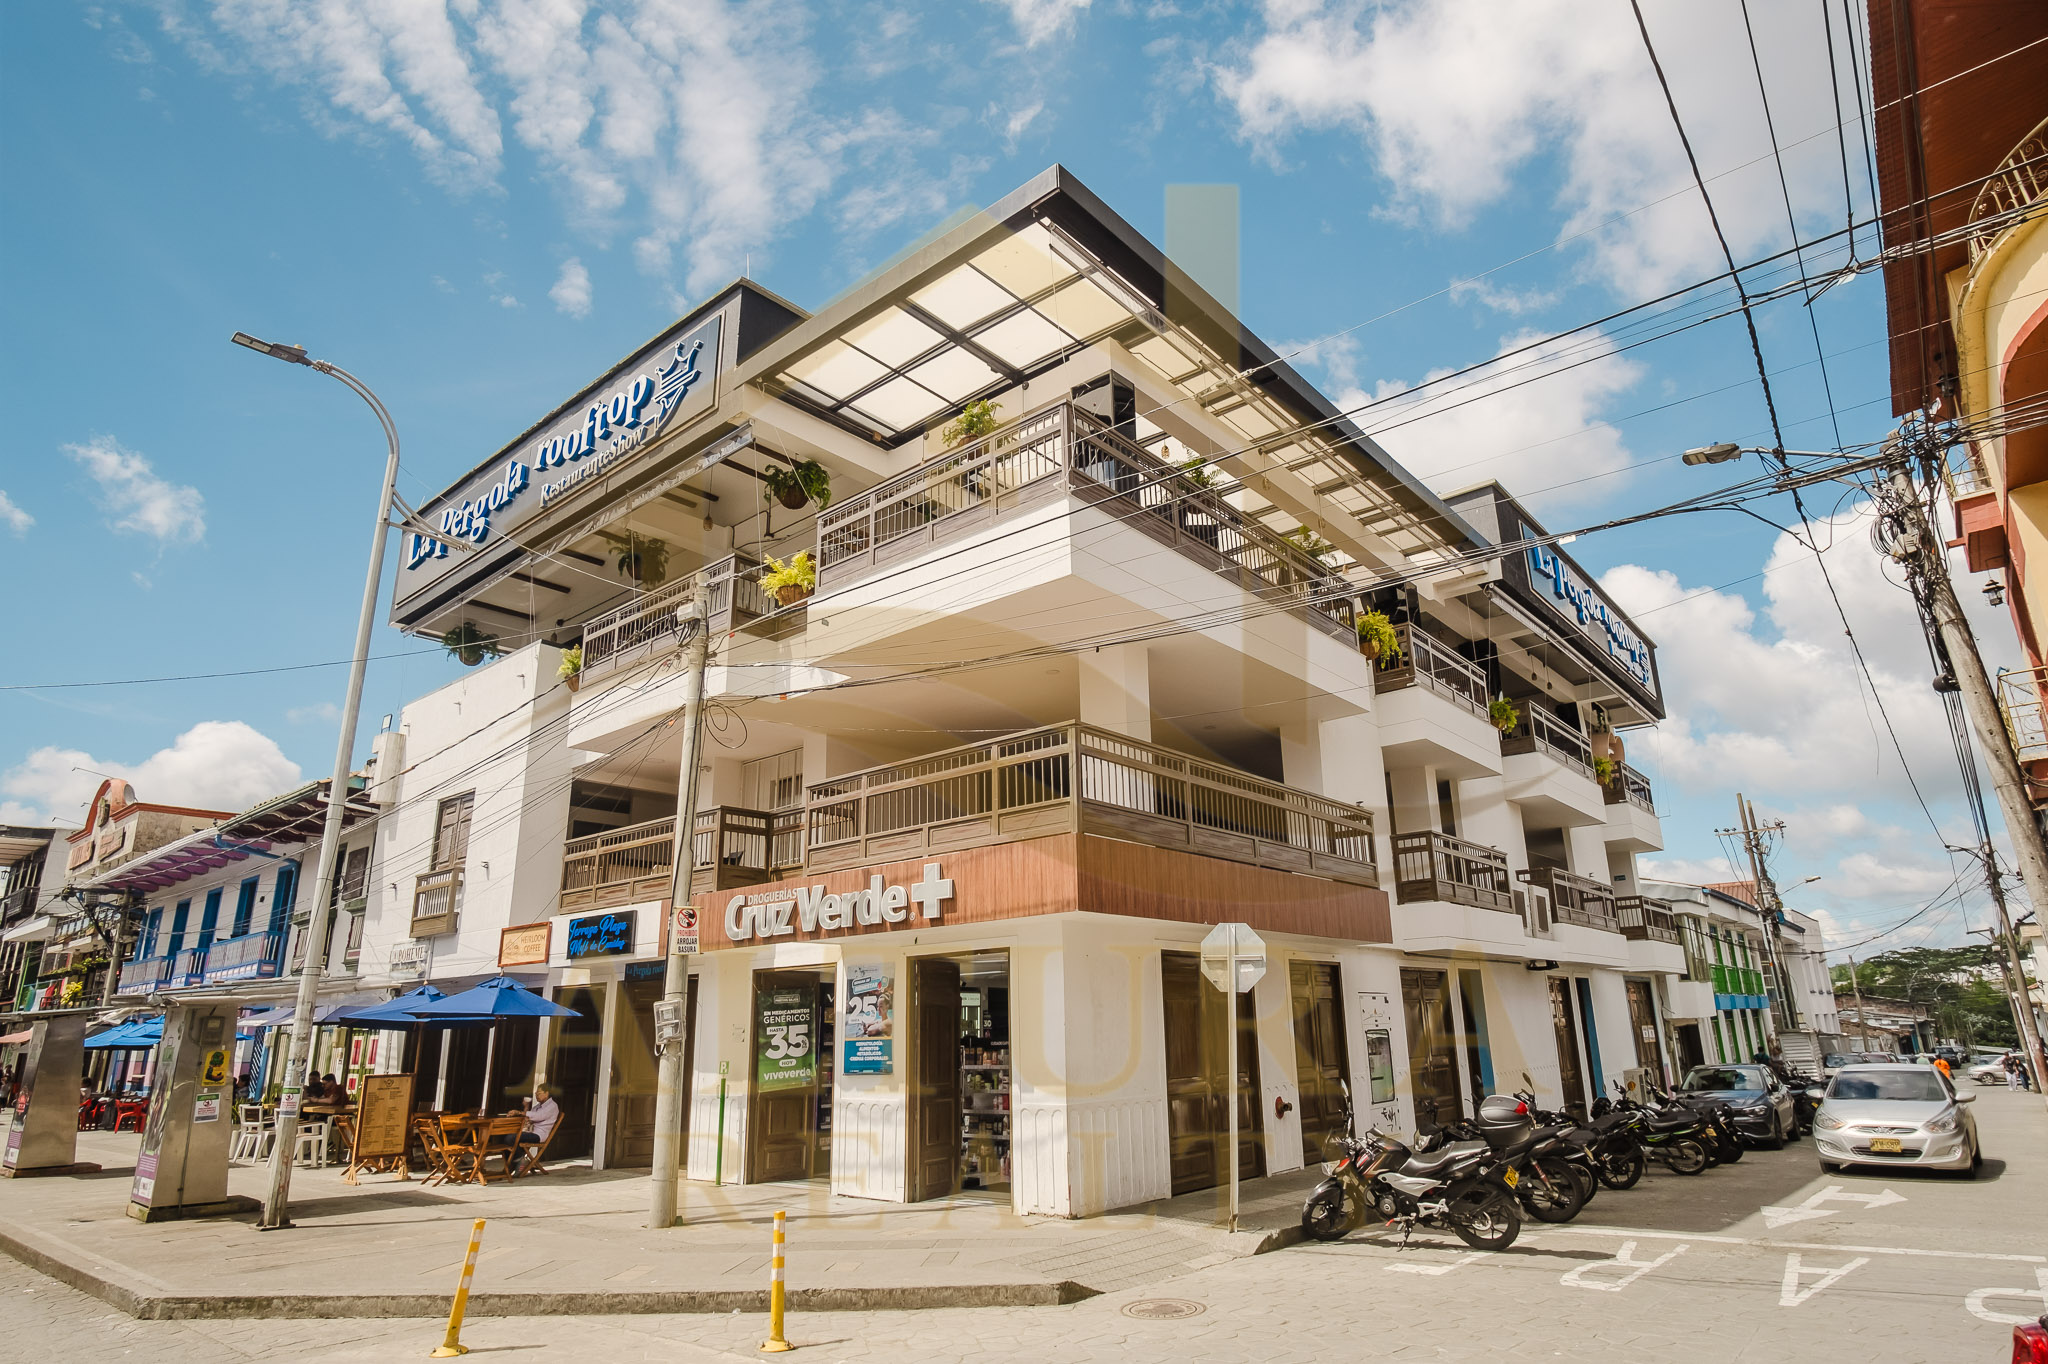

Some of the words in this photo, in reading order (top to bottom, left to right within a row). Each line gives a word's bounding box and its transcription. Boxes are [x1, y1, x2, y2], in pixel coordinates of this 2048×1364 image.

[406, 531, 433, 569] La
[533, 374, 654, 472] rooftop
[1533, 545, 1556, 579] La
[747, 887, 798, 905] DROGUERÍAS
[725, 894, 797, 941] Cruz
[797, 874, 908, 933] Verde
[521, 934, 546, 944] HEIRLOOM
[524, 943, 541, 952] COFFEE
[764, 1068, 811, 1081] viveverde
